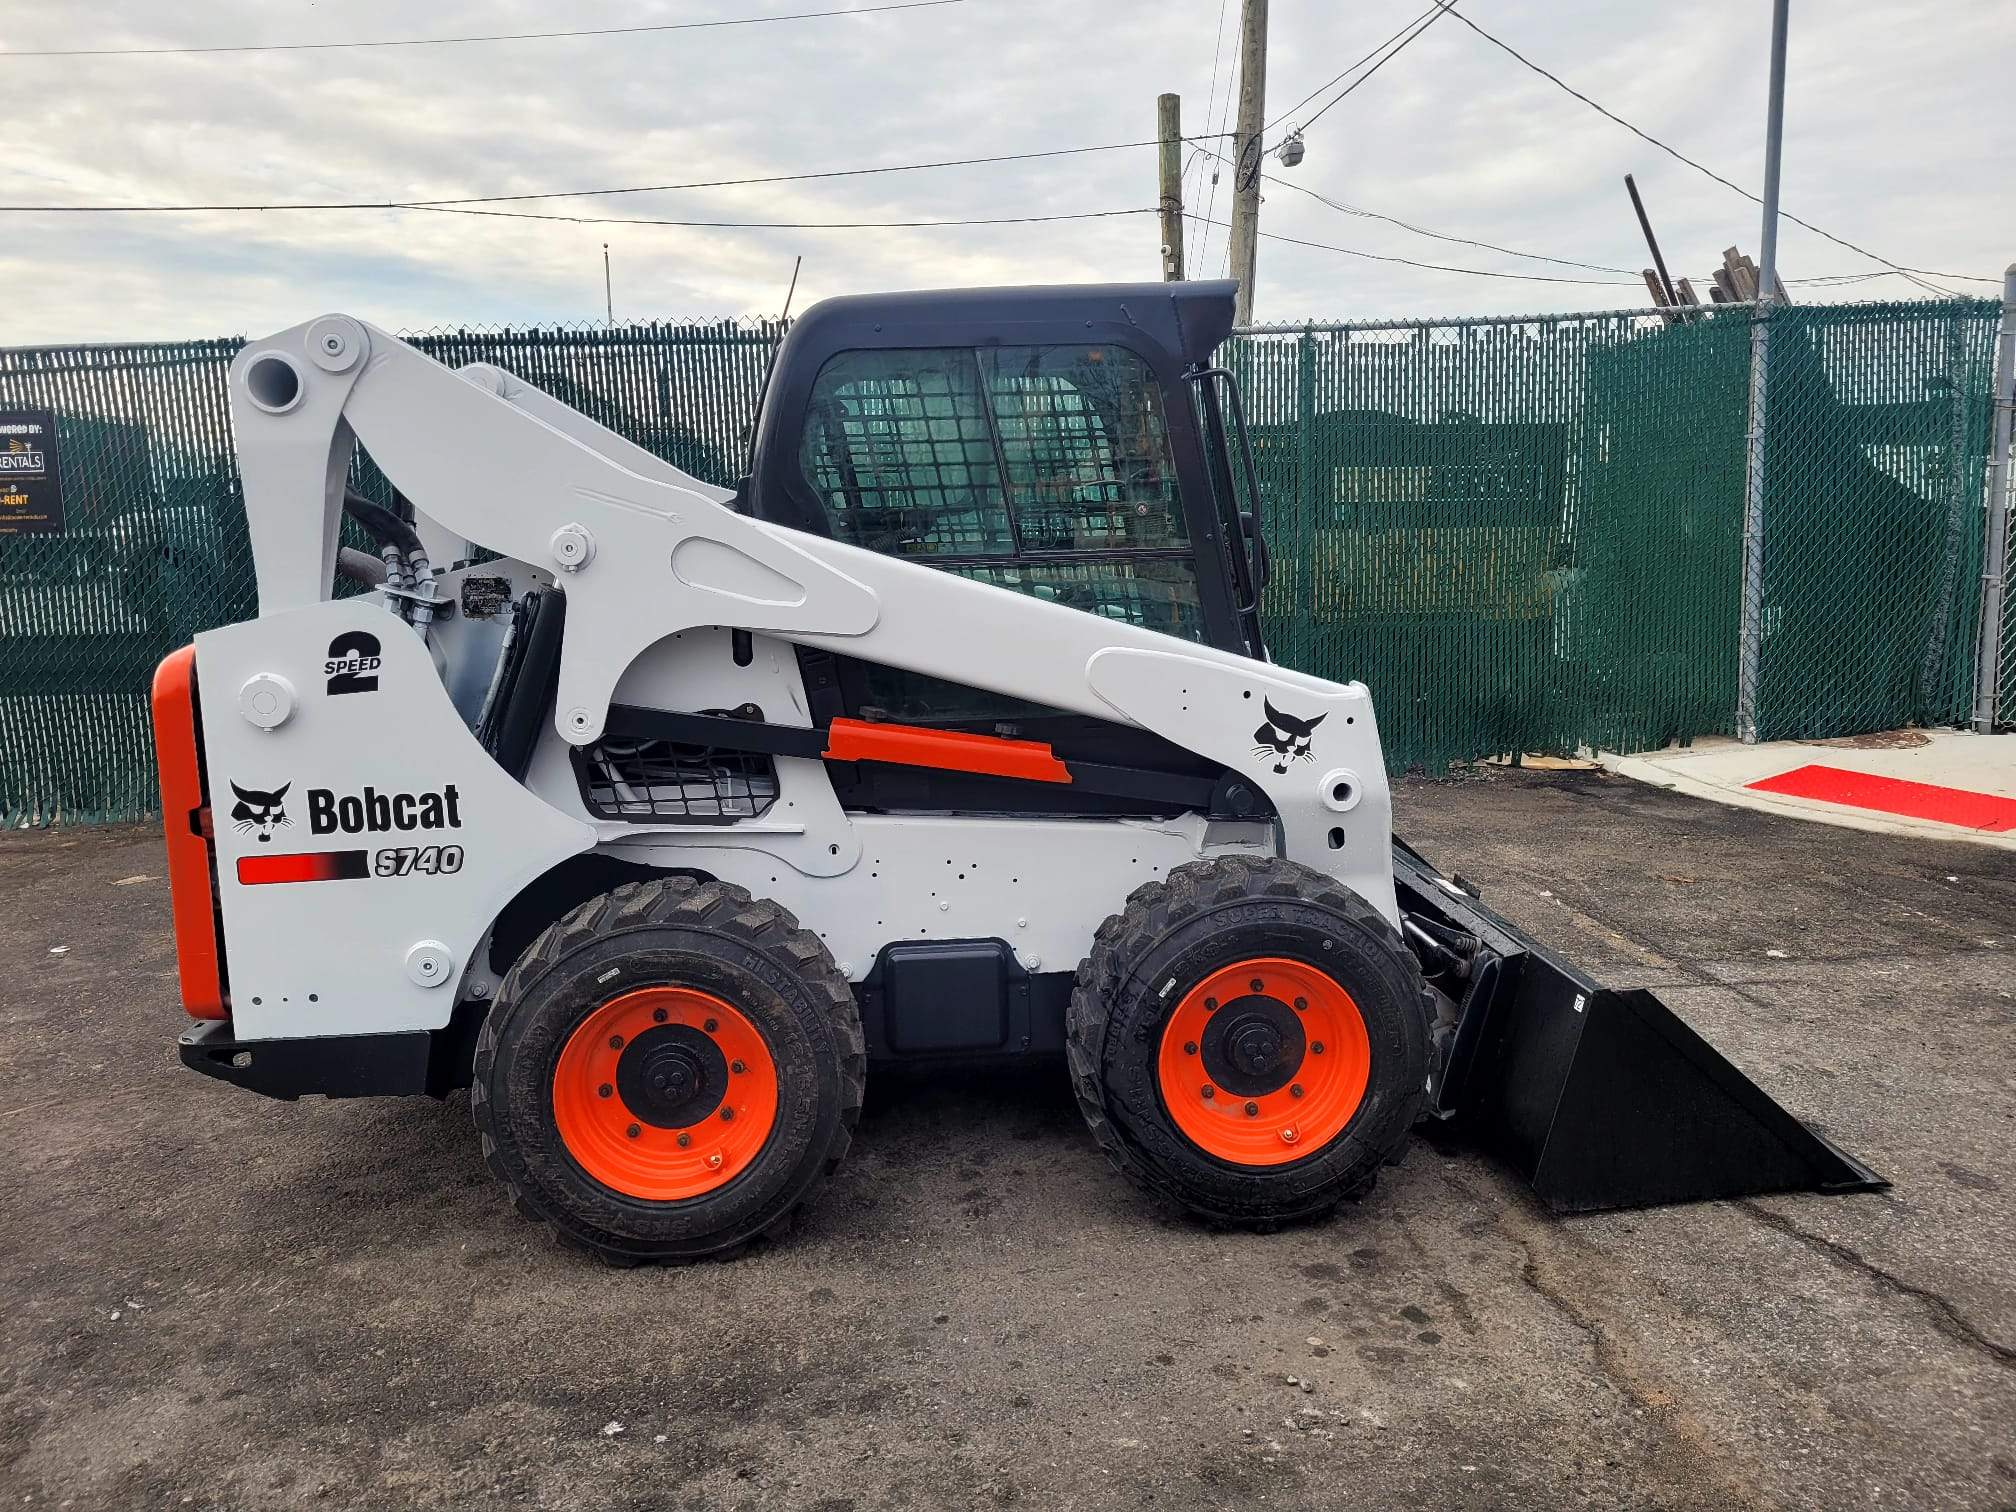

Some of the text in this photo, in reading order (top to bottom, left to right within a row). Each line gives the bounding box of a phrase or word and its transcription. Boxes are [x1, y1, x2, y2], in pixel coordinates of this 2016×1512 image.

[0, 495, 29, 506] -RENT
[324, 657, 382, 675] SPEED
[327, 630, 382, 696] 2
[307, 784, 462, 835] Bobcat
[375, 845, 464, 878] S740
